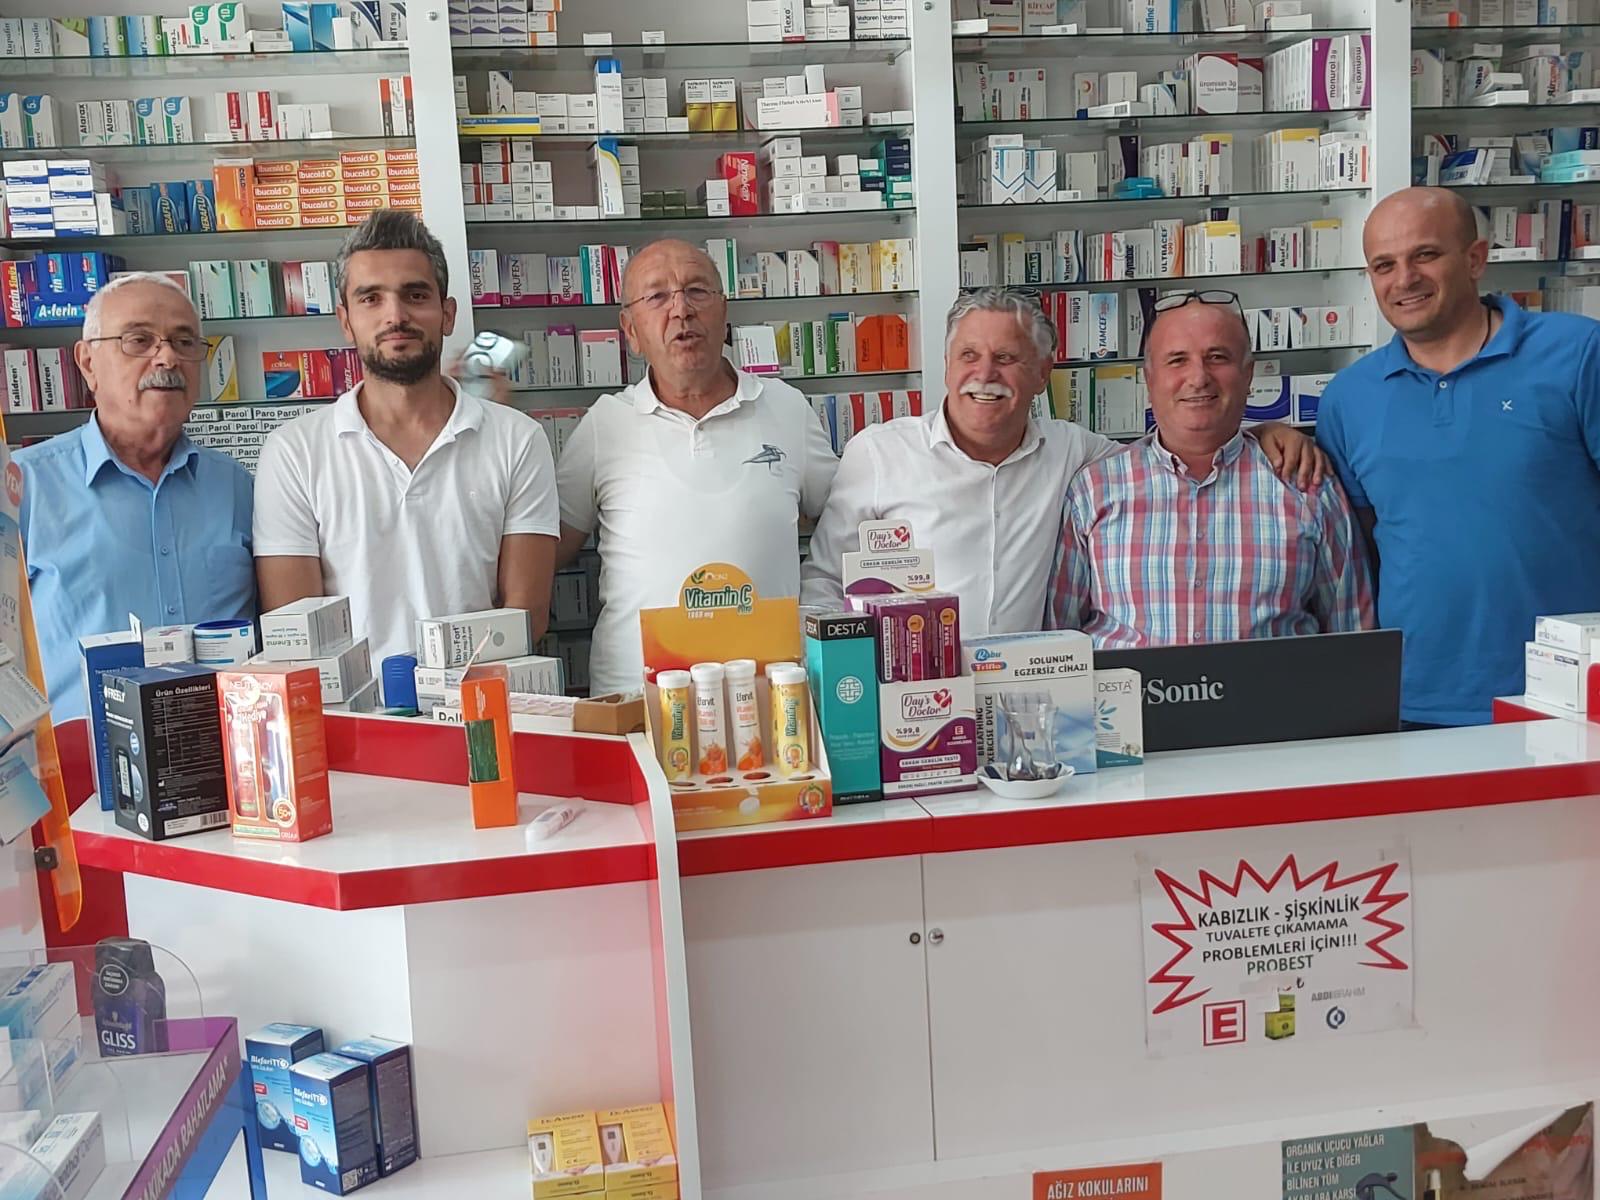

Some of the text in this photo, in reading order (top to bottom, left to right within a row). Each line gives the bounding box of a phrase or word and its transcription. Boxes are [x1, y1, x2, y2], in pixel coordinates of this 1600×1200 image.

[472, 262, 482, 296] BRUFEN
[512, 260, 522, 297] BRUFEN
[561, 264, 570, 298] BRUFEN
[11, 366, 21, 407] Kalidren
[43, 364, 54, 406] Kalidren
[191, 412, 214, 420] Parol
[225, 410, 248, 418] Parol
[277, 408, 300, 417] Parol
[208, 424, 231, 432] Parol
[236, 422, 258, 430] Parol
[210, 436, 233, 444] Parol
[237, 435, 260, 443] Parol
[238, 448, 260, 456] Parol
[874, 540, 902, 550] Doctor
[684, 584, 752, 609] Vitamin C
[827, 620, 866, 636] DESTA
[1029, 654, 1074, 665] SOLUNUM
[1014, 664, 1088, 676] EGZERSİZ CİHAZI
[155, 688, 174, 697] Ürün
[1098, 680, 1132, 693] DESTA
[908, 706, 941, 717] Doctor
[985, 696, 994, 727] DEVICE
[976, 708, 984, 756] BREATHING
[1198, 906, 1270, 928] KABIZLIK
[1284, 894, 1360, 922] ŞİŞKİNLİK
[1206, 918, 1348, 942] TUVALETE ÇIKAMAMA
[1202, 934, 1358, 963] PROBLEMLERİ İÇİN!!!
[1248, 954, 1314, 975] PROBEST
[1212, 1006, 1238, 1040] E
[102, 1030, 136, 1050] GLISS
[1286, 1134, 1384, 1157] ORGANİK UÇUCU YAĞLAR
[1301, 1160, 1322, 1172] UYUZ
[1324, 1158, 1335, 1169] VE
[1336, 1154, 1360, 1167] DİĞER
[1048, 1176, 1149, 1200] AĞIZ KOKULARINI
[1287, 1173, 1339, 1190] BİLİNEN TÜM
